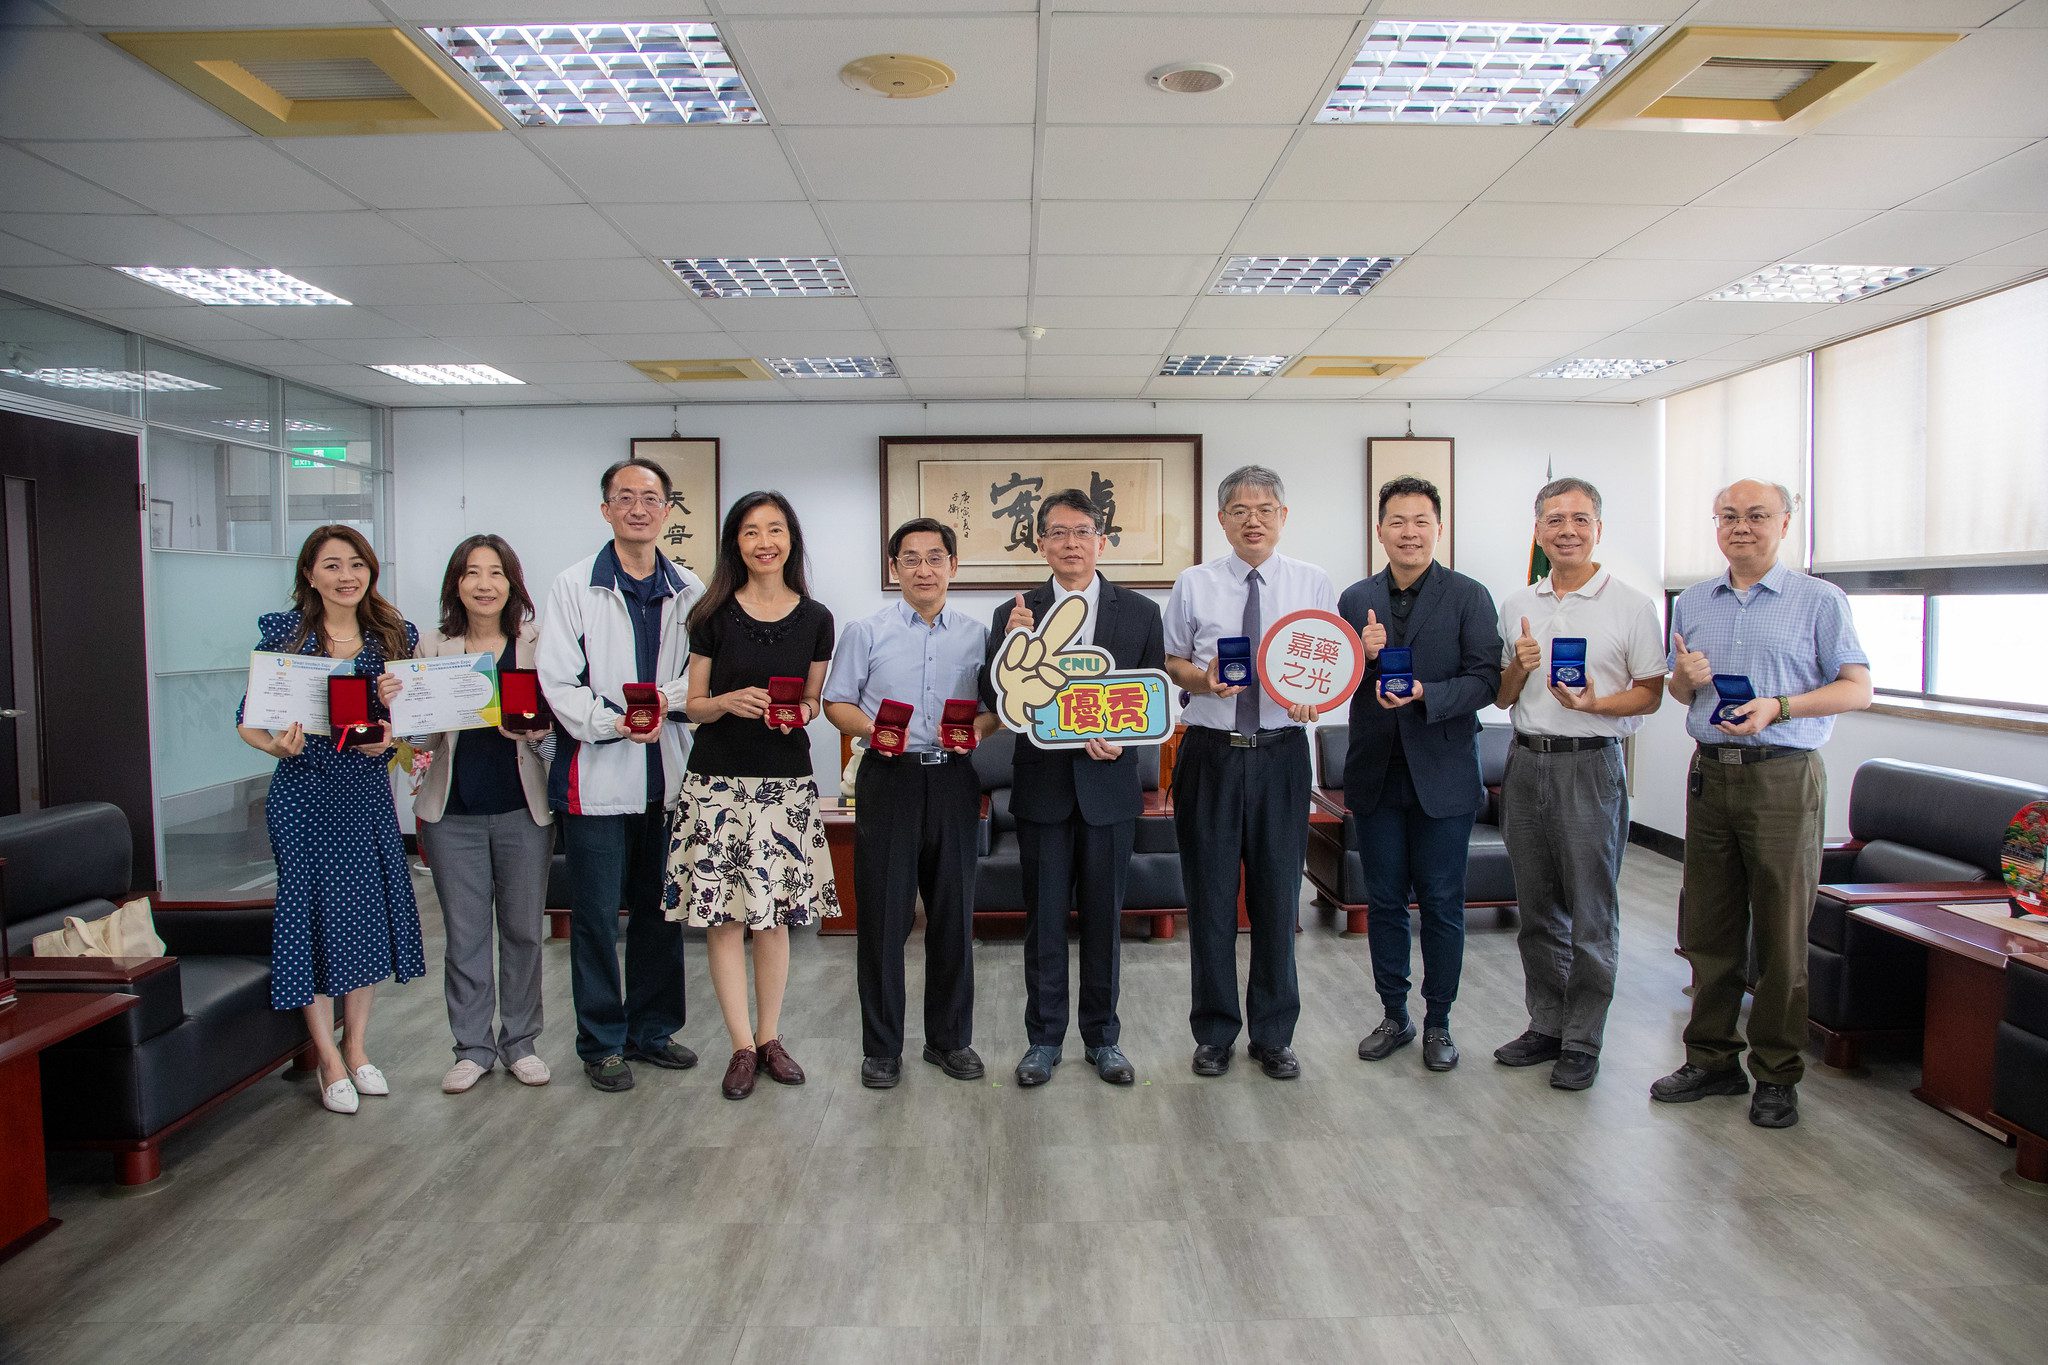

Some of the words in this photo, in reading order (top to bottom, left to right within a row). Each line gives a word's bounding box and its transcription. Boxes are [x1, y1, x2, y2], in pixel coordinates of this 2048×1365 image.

[1058, 657, 1100, 672] CNU
[1286, 631, 1342, 666] 嘉藥
[1278, 661, 1332, 695] 之光
[1059, 685, 1146, 731] 優秀
